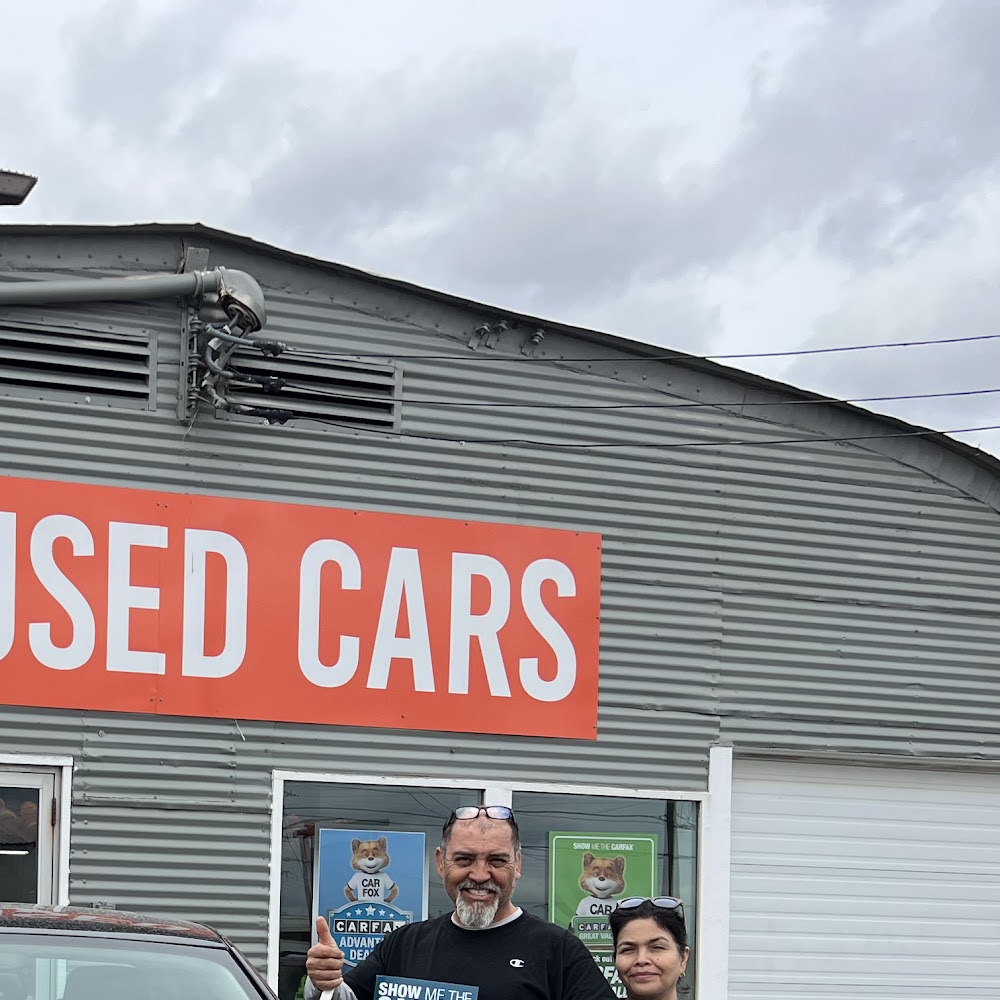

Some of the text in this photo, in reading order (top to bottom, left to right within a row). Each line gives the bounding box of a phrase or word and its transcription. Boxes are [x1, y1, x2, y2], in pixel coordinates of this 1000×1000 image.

[298, 538, 577, 703] CARS
[573, 842, 591, 850] SHOW
[600, 843, 610, 851] THE
[611, 843, 634, 851] CARFAX
[361, 878, 380, 888] CAR
[362, 888, 380, 897] FOX
[590, 903, 613, 916] CAR
[578, 923, 613, 931] CARFA
[578, 932, 613, 940] GREAT VAL
[339, 936, 384, 948] ADVANT
[349, 949, 374, 960] DEA
[378, 982, 422, 1000] SHOW
